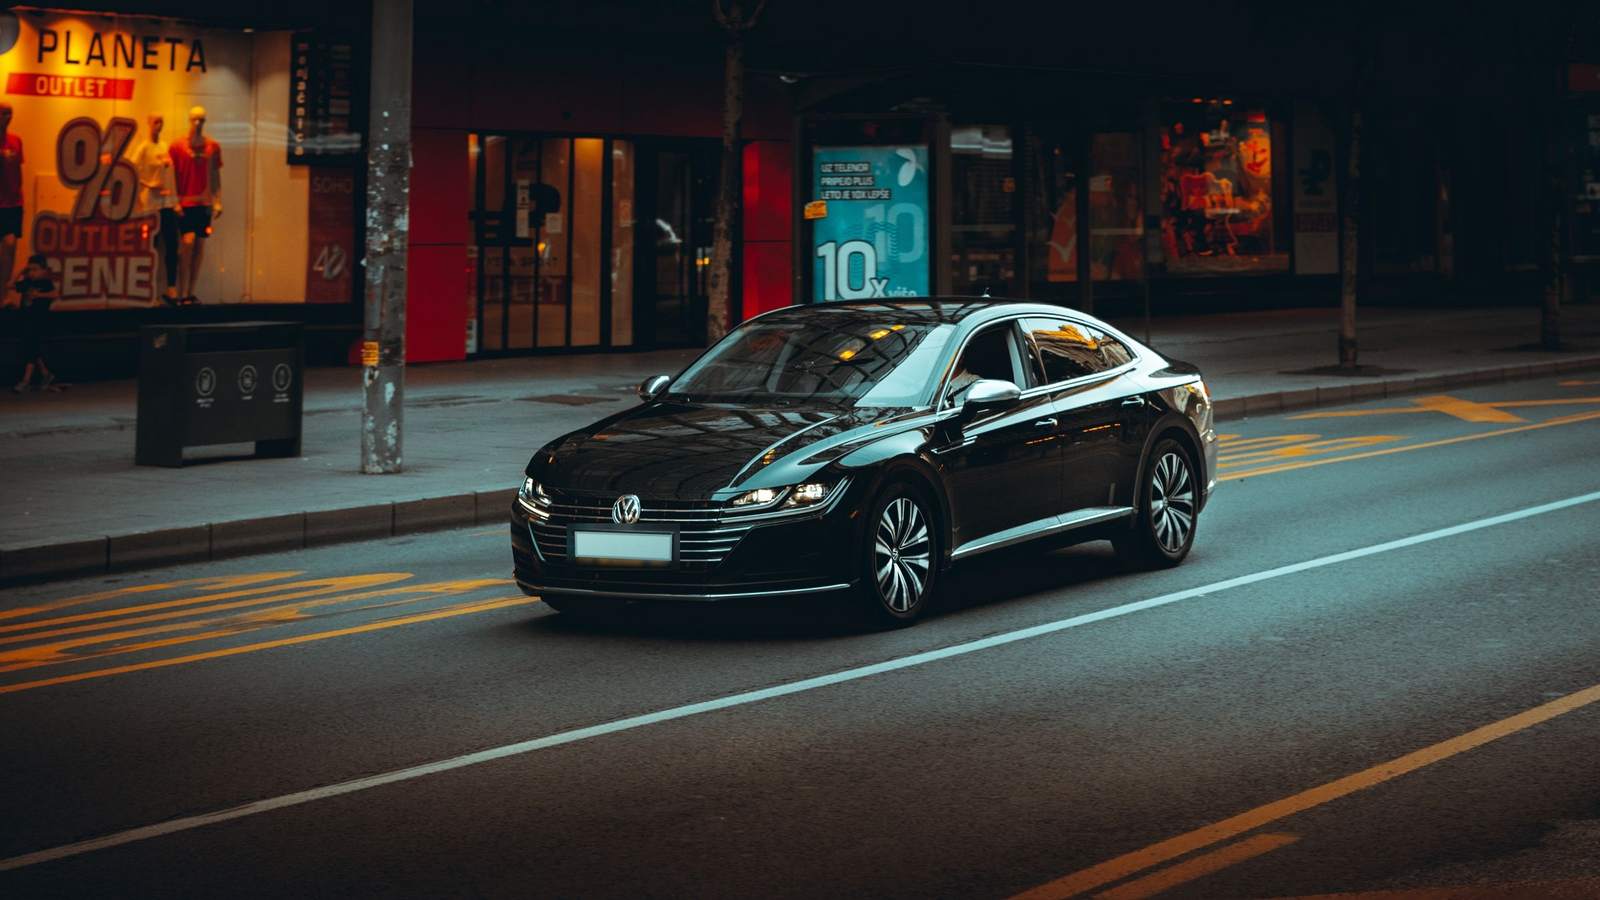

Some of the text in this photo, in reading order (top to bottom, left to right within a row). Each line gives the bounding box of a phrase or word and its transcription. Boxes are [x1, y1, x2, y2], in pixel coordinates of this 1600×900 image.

[37, 29, 207, 73] PLANETA
[35, 76, 108, 98] OUTLET
[834, 163, 870, 172] TELENOR
[312, 176, 353, 193] SOHO
[853, 177, 873, 186] PLUS
[820, 190, 842, 199] LETO
[36, 218, 155, 253] OUTLET
[864, 202, 924, 264] 10
